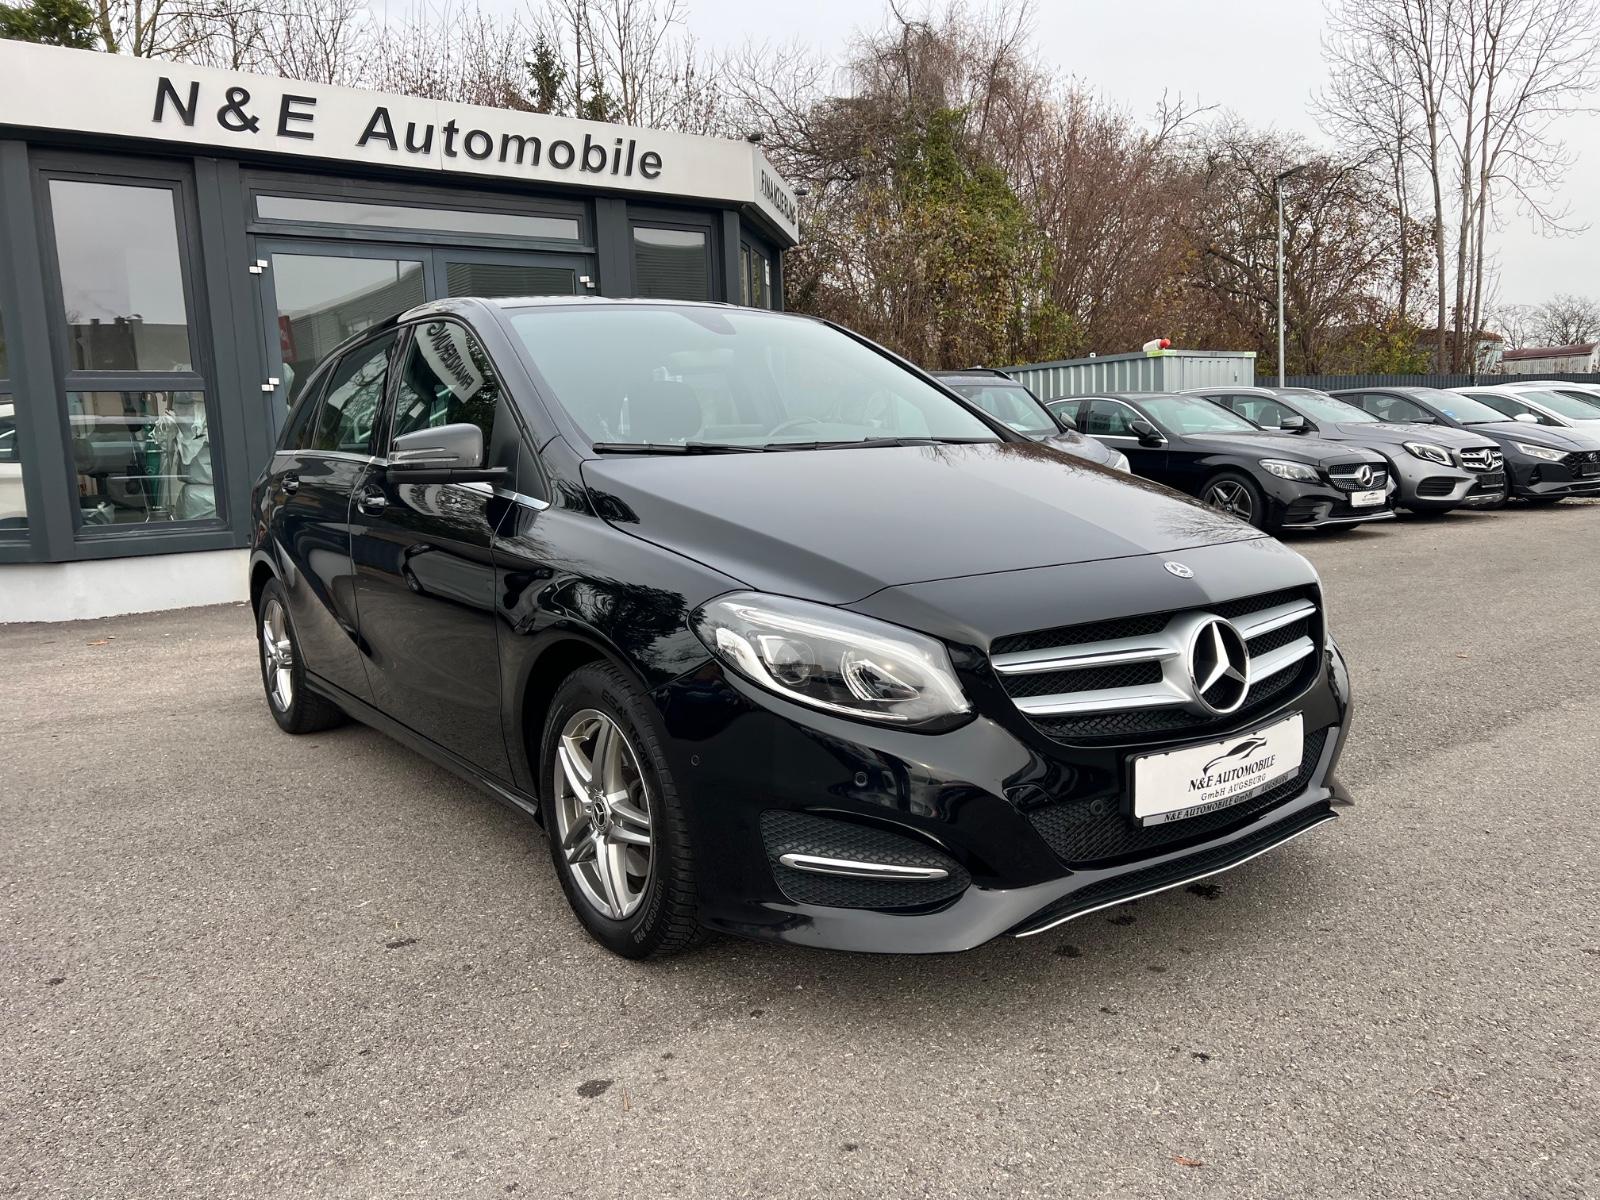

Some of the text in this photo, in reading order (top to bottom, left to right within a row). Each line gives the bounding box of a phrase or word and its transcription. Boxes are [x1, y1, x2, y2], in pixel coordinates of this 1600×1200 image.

[355, 106, 663, 180] Automobile
[1187, 754, 1276, 792] N&E AUTOMOBILE
[1201, 773, 1266, 801] GmbH AUGSBURG
[1183, 798, 1234, 819] AUTOMOBILE
